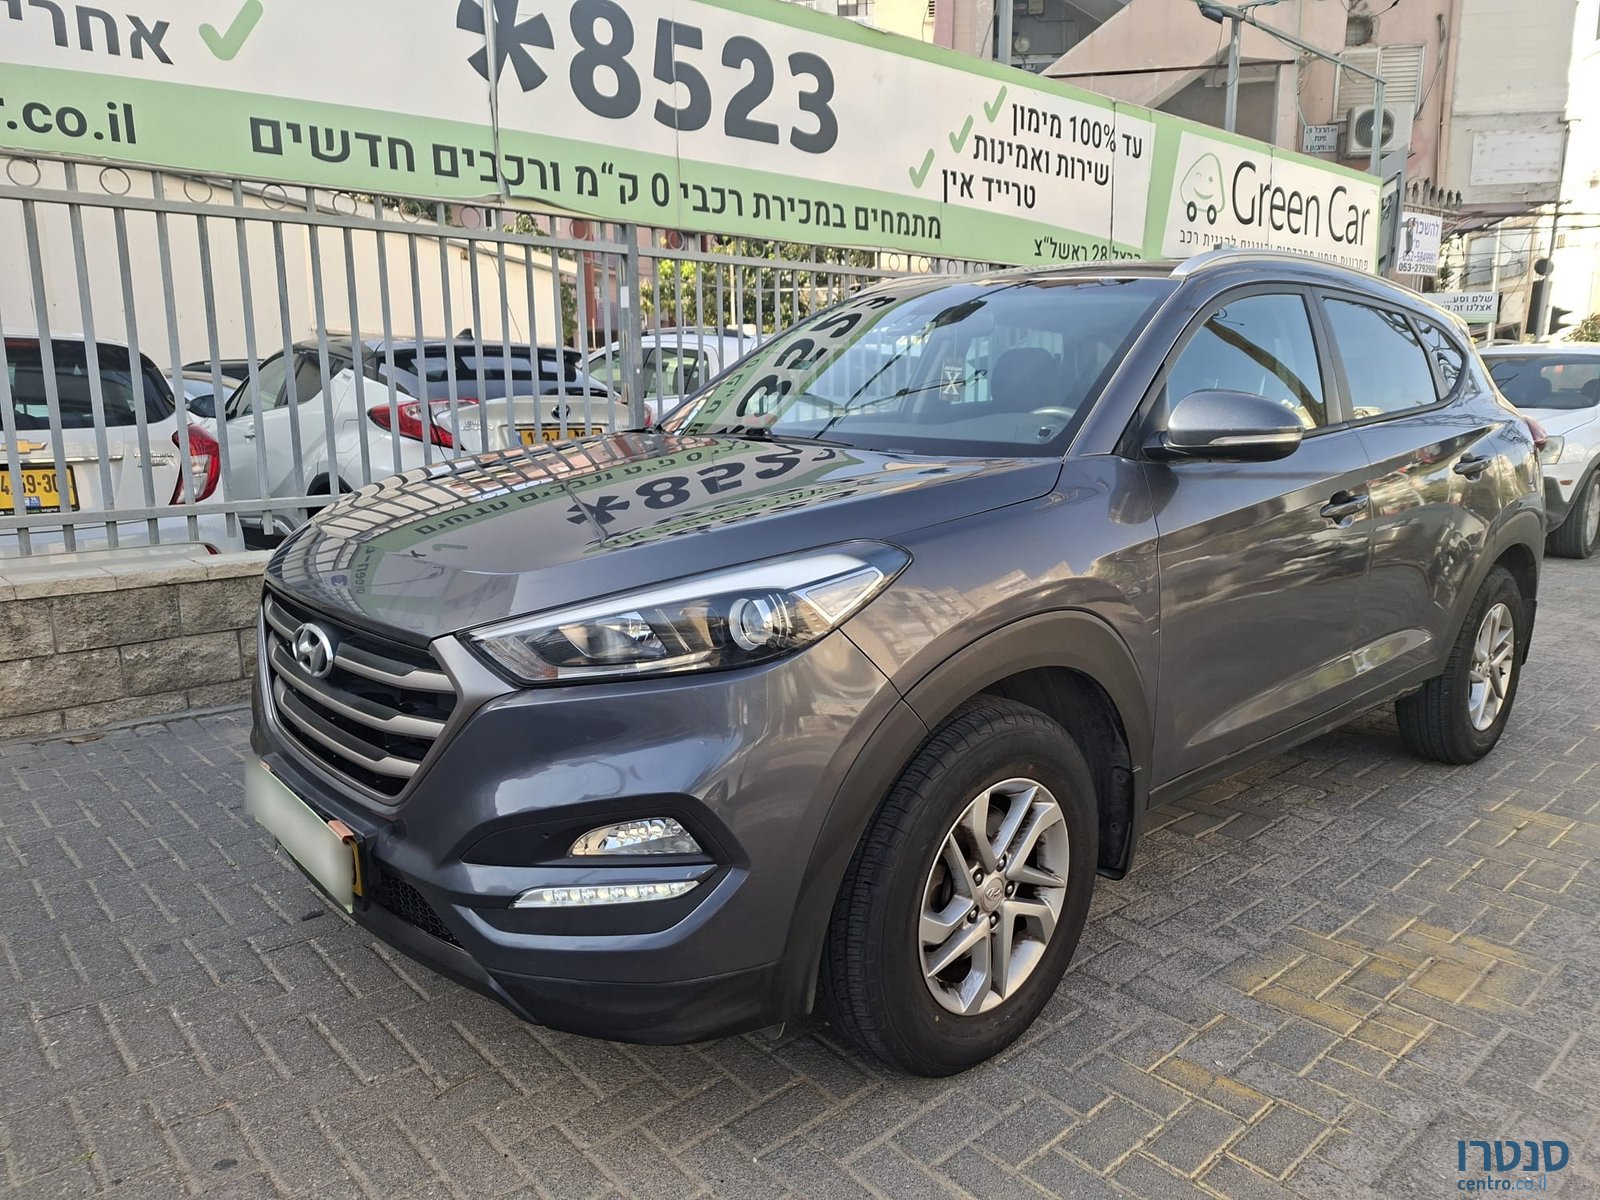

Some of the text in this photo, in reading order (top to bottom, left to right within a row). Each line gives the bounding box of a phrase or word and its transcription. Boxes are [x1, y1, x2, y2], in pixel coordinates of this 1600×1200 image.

[0, 97, 137, 144] .co.il
[1012, 103, 1142, 159] עד 100% מימון
[249, 116, 415, 172] חדשים
[973, 134, 1109, 186] שירות ואמינות
[432, 143, 560, 192] ורכבים
[651, 172, 670, 207] 0
[680, 182, 743, 216] רכבי
[942, 169, 1036, 209] טרייד אין
[1232, 161, 1371, 246] Green Car
[753, 192, 846, 228] במכירת
[855, 206, 941, 239] מתמחים
[1415, 221, 1440, 237] להשכר
[1180, 229, 1199, 245] רכב
[1472, 294, 1493, 303] שלם
